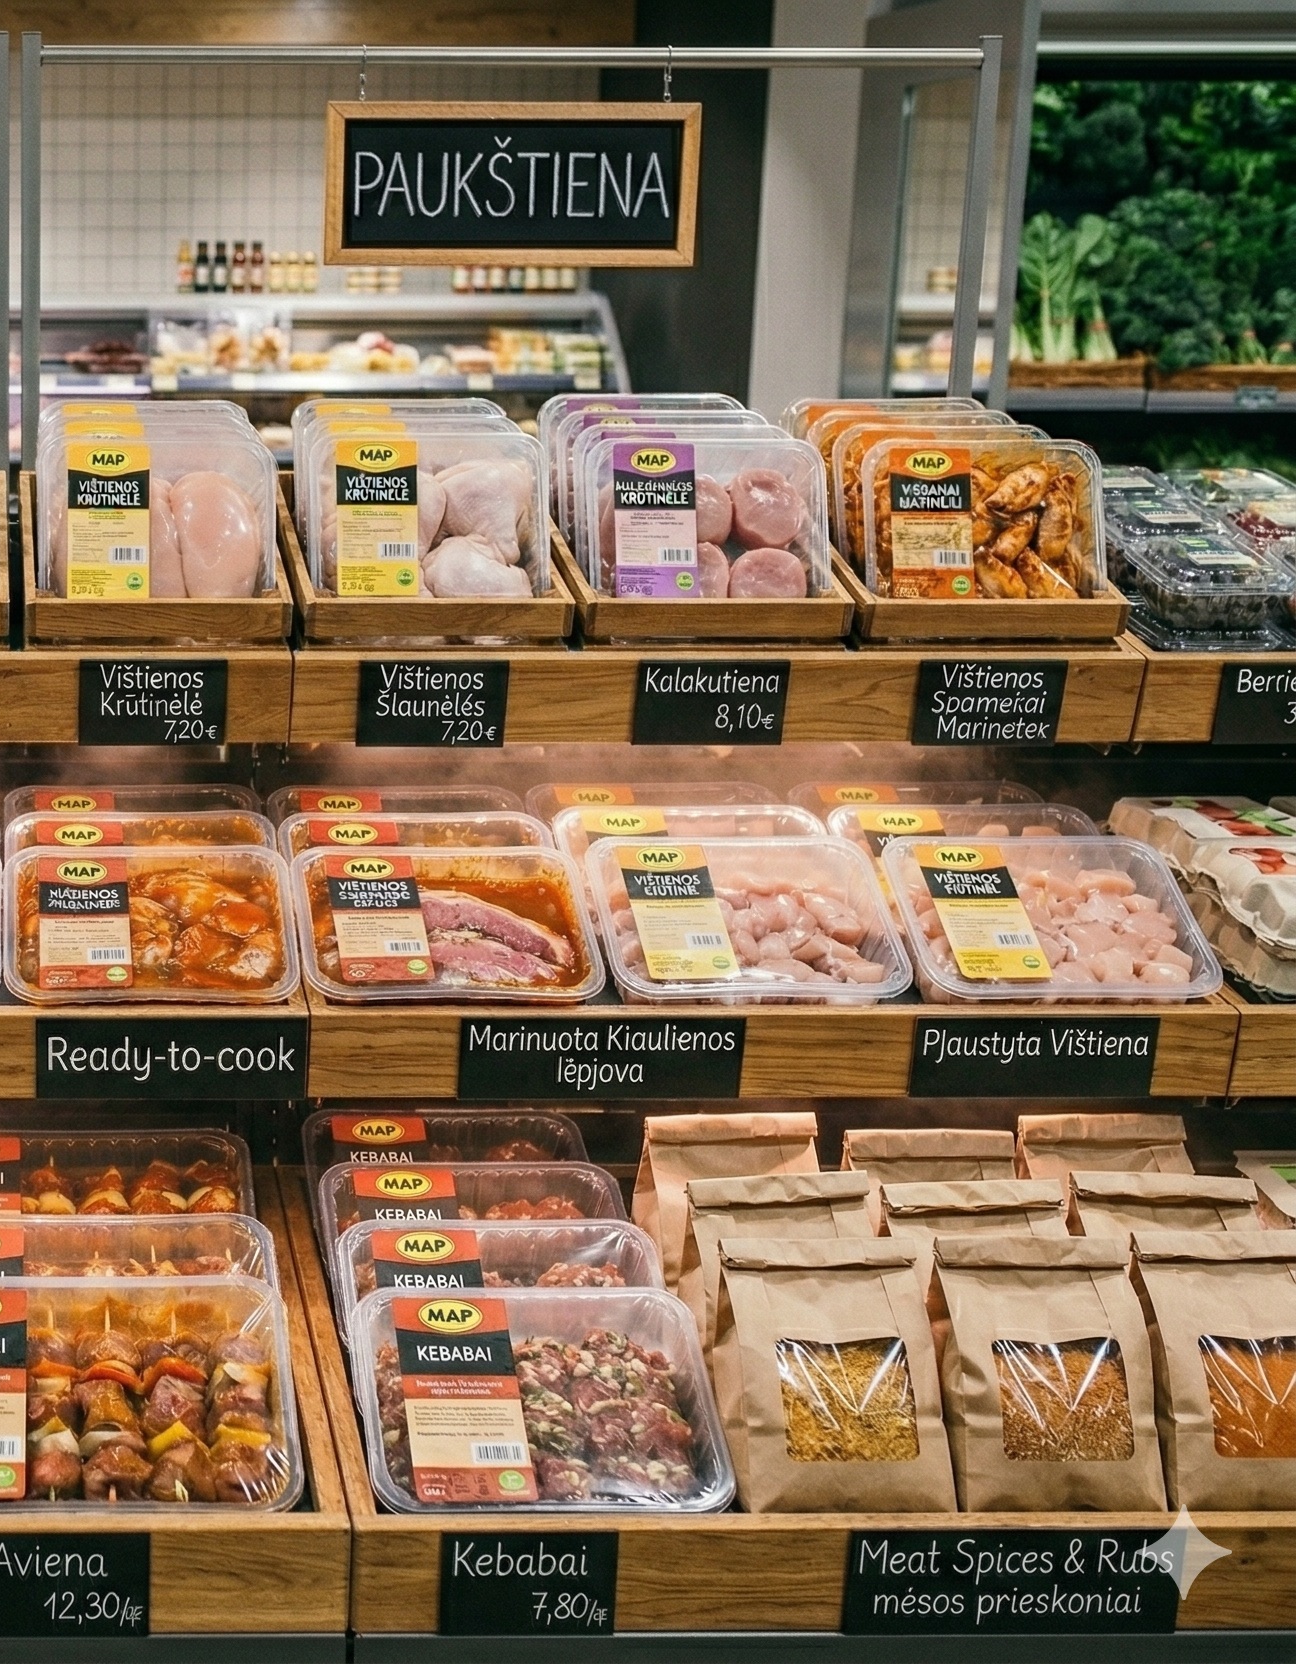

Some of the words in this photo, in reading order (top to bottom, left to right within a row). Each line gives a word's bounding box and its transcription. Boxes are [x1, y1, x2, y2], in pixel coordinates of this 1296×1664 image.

[354, 136, 671, 218] PAUKŠTIENA
[91, 454, 125, 466] MAP
[359, 449, 393, 461] MAP
[636, 454, 670, 466] MAP
[912, 457, 946, 469] MAP
[100, 664, 204, 691] Vištienos
[380, 663, 484, 691] Vištienos
[644, 667, 780, 694] Kalakutiena
[942, 663, 1044, 689] Vištienos
[57, 800, 91, 809] MAP
[323, 800, 357, 809] MAP
[606, 818, 641, 828] MAP
[61, 831, 97, 840] MAP
[335, 830, 372, 839] MAP
[642, 852, 679, 863] MAP
[940, 852, 977, 863] MAP
[62, 866, 101, 877] MAP
[350, 863, 388, 874] MAP
[469, 1025, 599, 1052] Marinuota
[607, 1024, 736, 1052] Kiaulienos
[1050, 1028, 1149, 1056] Vištiena
[47, 1036, 295, 1082] Ready-to-cook
[359, 1125, 396, 1136] MAP
[384, 1178, 424, 1190] MAP
[404, 1240, 446, 1252] MAP
[394, 1274, 465, 1288] KEBABAI
[427, 1309, 473, 1323] MAP
[416, 1345, 493, 1362] KEBABAI
[454, 1541, 589, 1578] Kebabai
[858, 1538, 941, 1575] Meat
[952, 1538, 1054, 1584] Spices
[1063, 1538, 1086, 1575] &
[1097, 1538, 1175, 1575] Rubs
[975, 1584, 1142, 1625] prieskoniai
